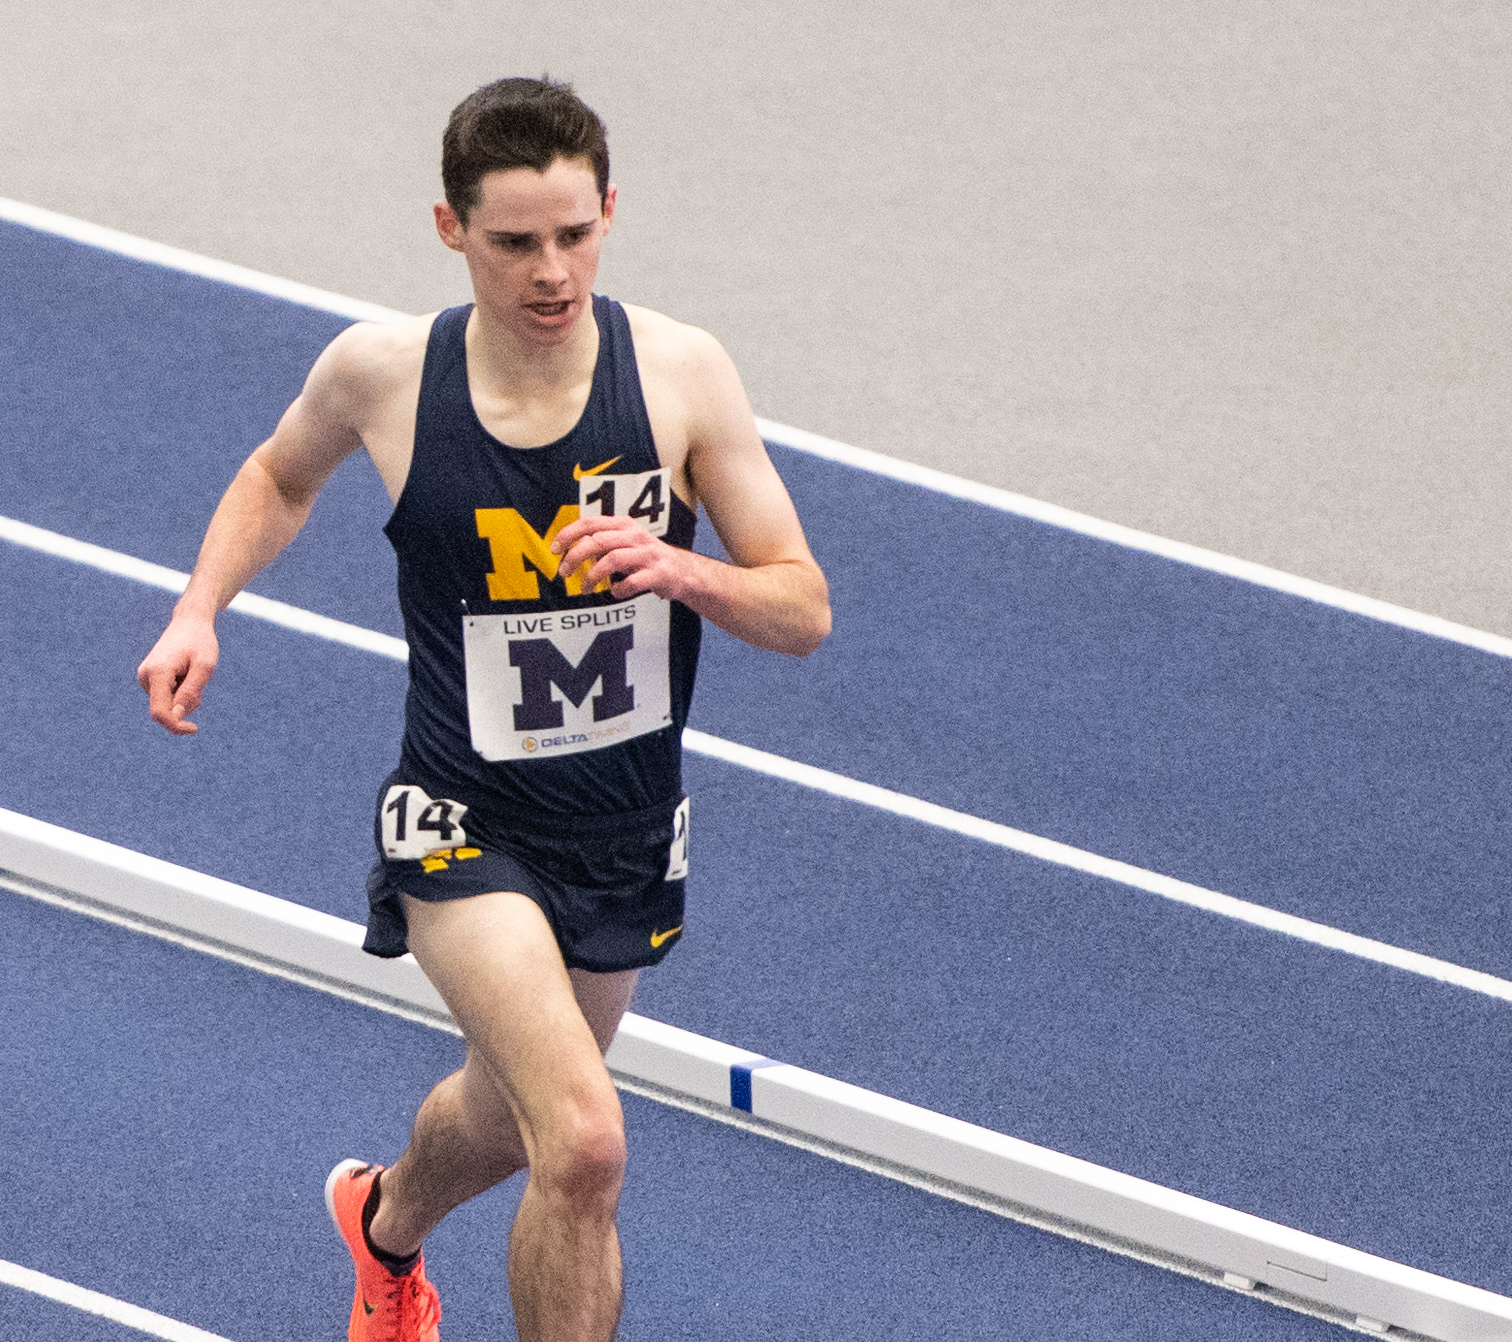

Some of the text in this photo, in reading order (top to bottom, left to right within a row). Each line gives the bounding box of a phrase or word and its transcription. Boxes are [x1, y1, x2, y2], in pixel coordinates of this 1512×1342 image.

[586, 475, 665, 524] 14
[475, 505, 612, 600] M
[504, 605, 636, 635] LIVE SPLITS
[508, 623, 635, 731] M
[386, 790, 457, 841] 14
